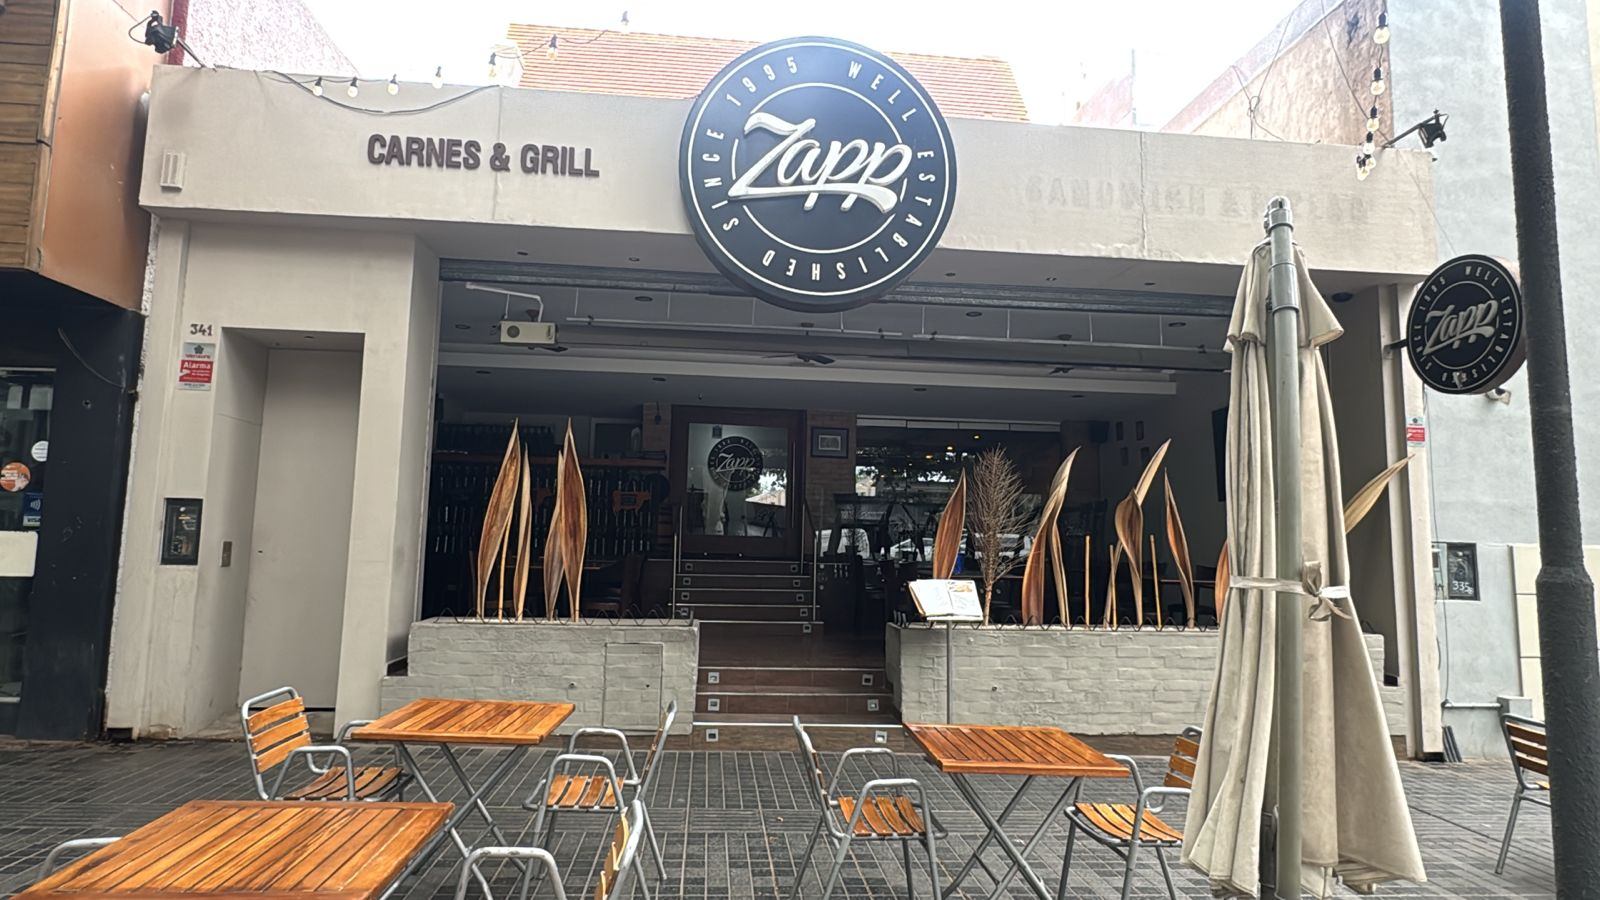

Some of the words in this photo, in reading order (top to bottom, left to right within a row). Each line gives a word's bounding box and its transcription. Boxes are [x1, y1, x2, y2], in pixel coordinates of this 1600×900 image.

[726, 56, 798, 107] 1995
[848, 60, 917, 123] WELL
[367, 133, 481, 170] CARNES
[489, 142, 511, 172] &
[520, 143, 600, 178] GRILL
[702, 128, 739, 232] SINCE
[727, 112, 913, 213] Zapp
[762, 149, 937, 281] ESTABLISHED
[190, 323, 213, 337] 341
[1422, 300, 1499, 355] Zapp
[183, 361, 211, 370] Alarma
[715, 453, 757, 476] Zapp
